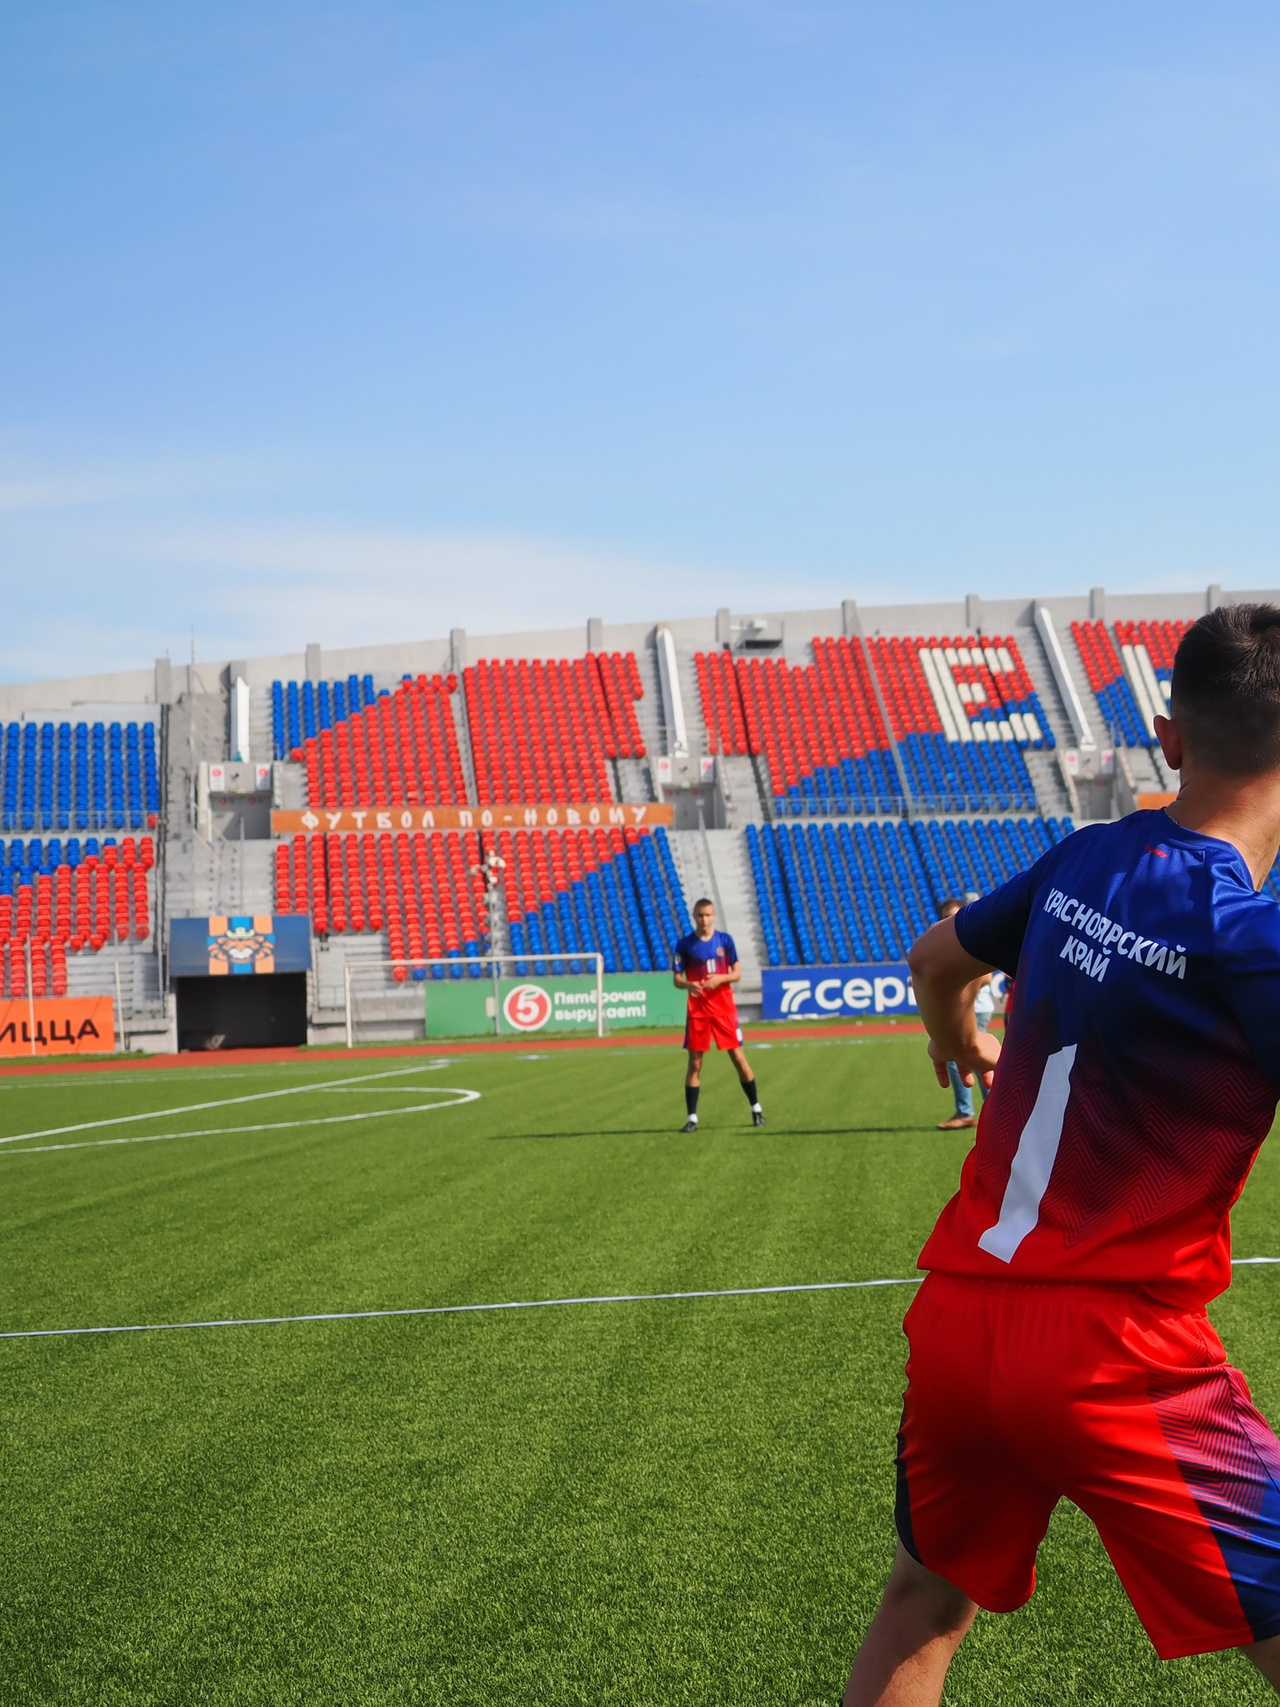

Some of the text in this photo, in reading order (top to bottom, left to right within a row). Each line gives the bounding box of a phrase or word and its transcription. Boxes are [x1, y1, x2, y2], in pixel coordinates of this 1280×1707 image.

[301, 806, 647, 830] ФУТБОЛ ПО-НОВОМУ
[1043, 888, 1187, 980] КРАСНОЯРСКИЙ
[1059, 935, 1112, 983] КРАЙ
[554, 989, 646, 1006] Пятёрочка
[554, 1004, 646, 1023] выруает!
[977, 1043, 1078, 1264] 1
